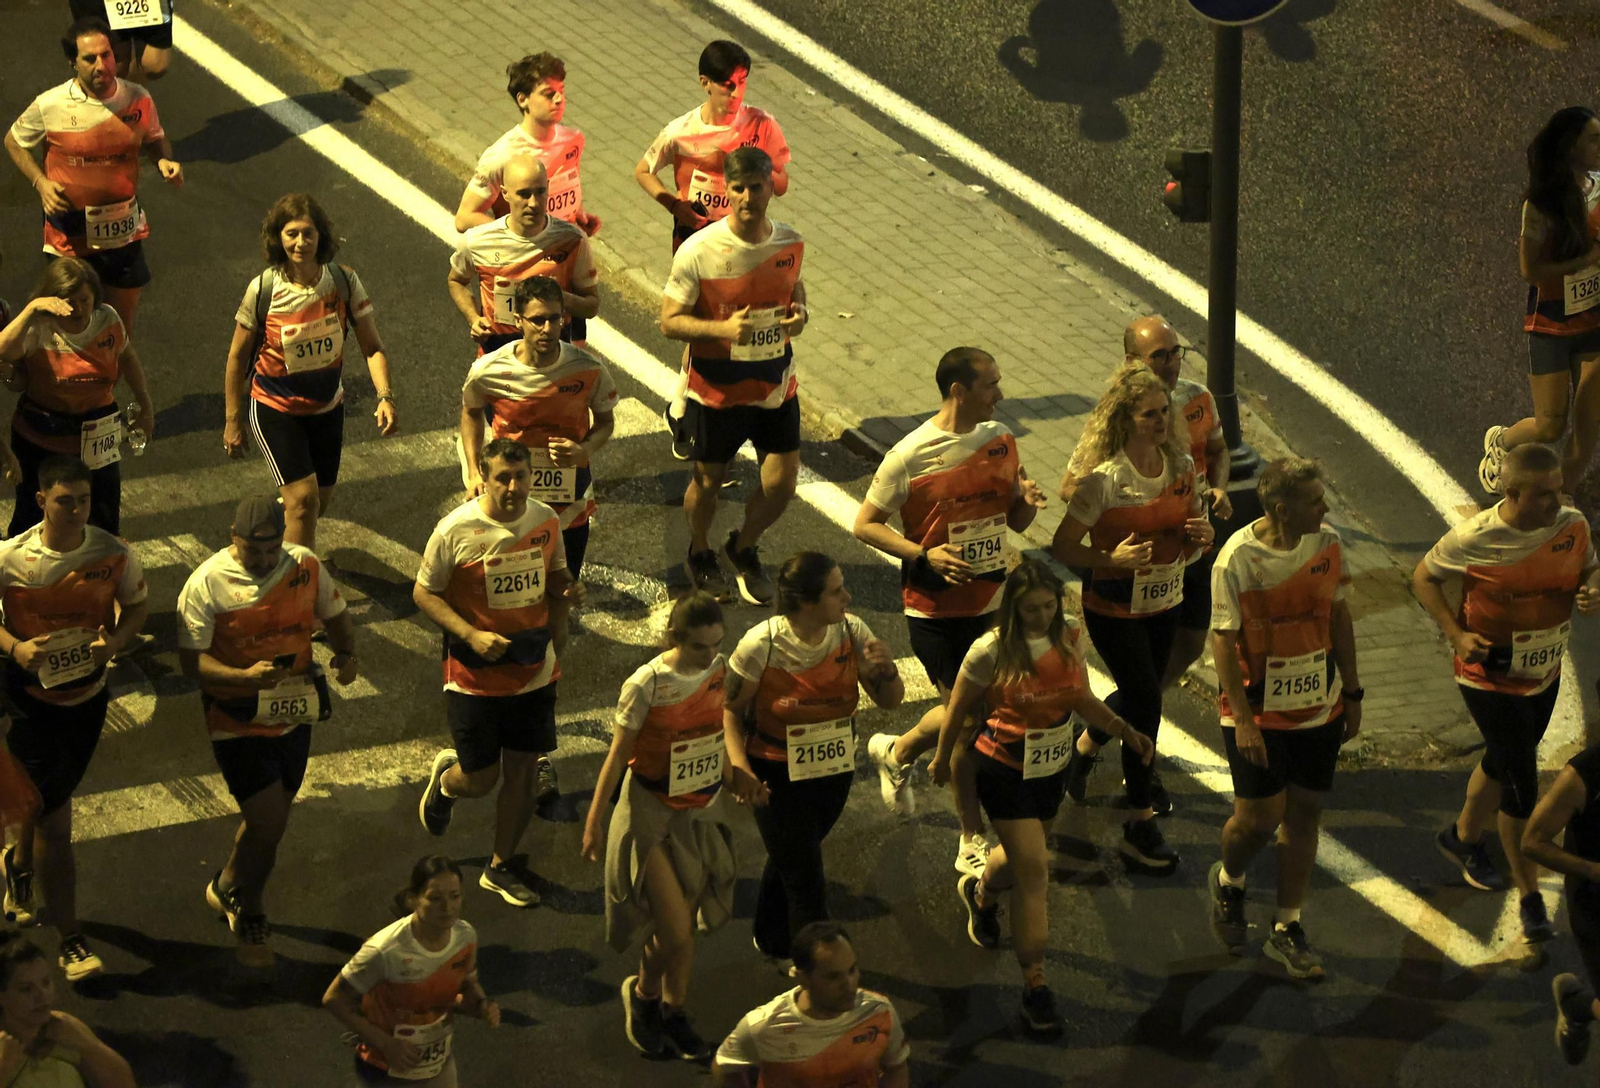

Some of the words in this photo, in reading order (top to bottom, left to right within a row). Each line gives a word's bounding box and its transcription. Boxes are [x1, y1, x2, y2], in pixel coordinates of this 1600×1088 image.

[116, 0, 149, 16] 9226
[546, 190, 576, 212] 0373
[695, 191, 731, 208] 1990
[93, 216, 135, 237] 11938
[776, 256, 793, 268] KH7
[1571, 277, 1599, 299] 1326
[295, 337, 334, 358] 3179
[559, 383, 582, 395] KH7
[92, 435, 115, 456] 1108
[530, 470, 563, 487] 206
[530, 533, 548, 546] KH7
[961, 536, 1002, 561] 15794
[1552, 537, 1574, 552] KH7
[1310, 560, 1328, 575] KH7
[493, 570, 540, 594] 22614
[1141, 574, 1180, 600] 16915
[48, 642, 91, 671] 9565
[1520, 643, 1562, 668] 16914
[1272, 673, 1320, 696] 21556
[269, 698, 308, 716] 9563
[795, 740, 846, 764] 21566
[676, 753, 719, 780] 21573
